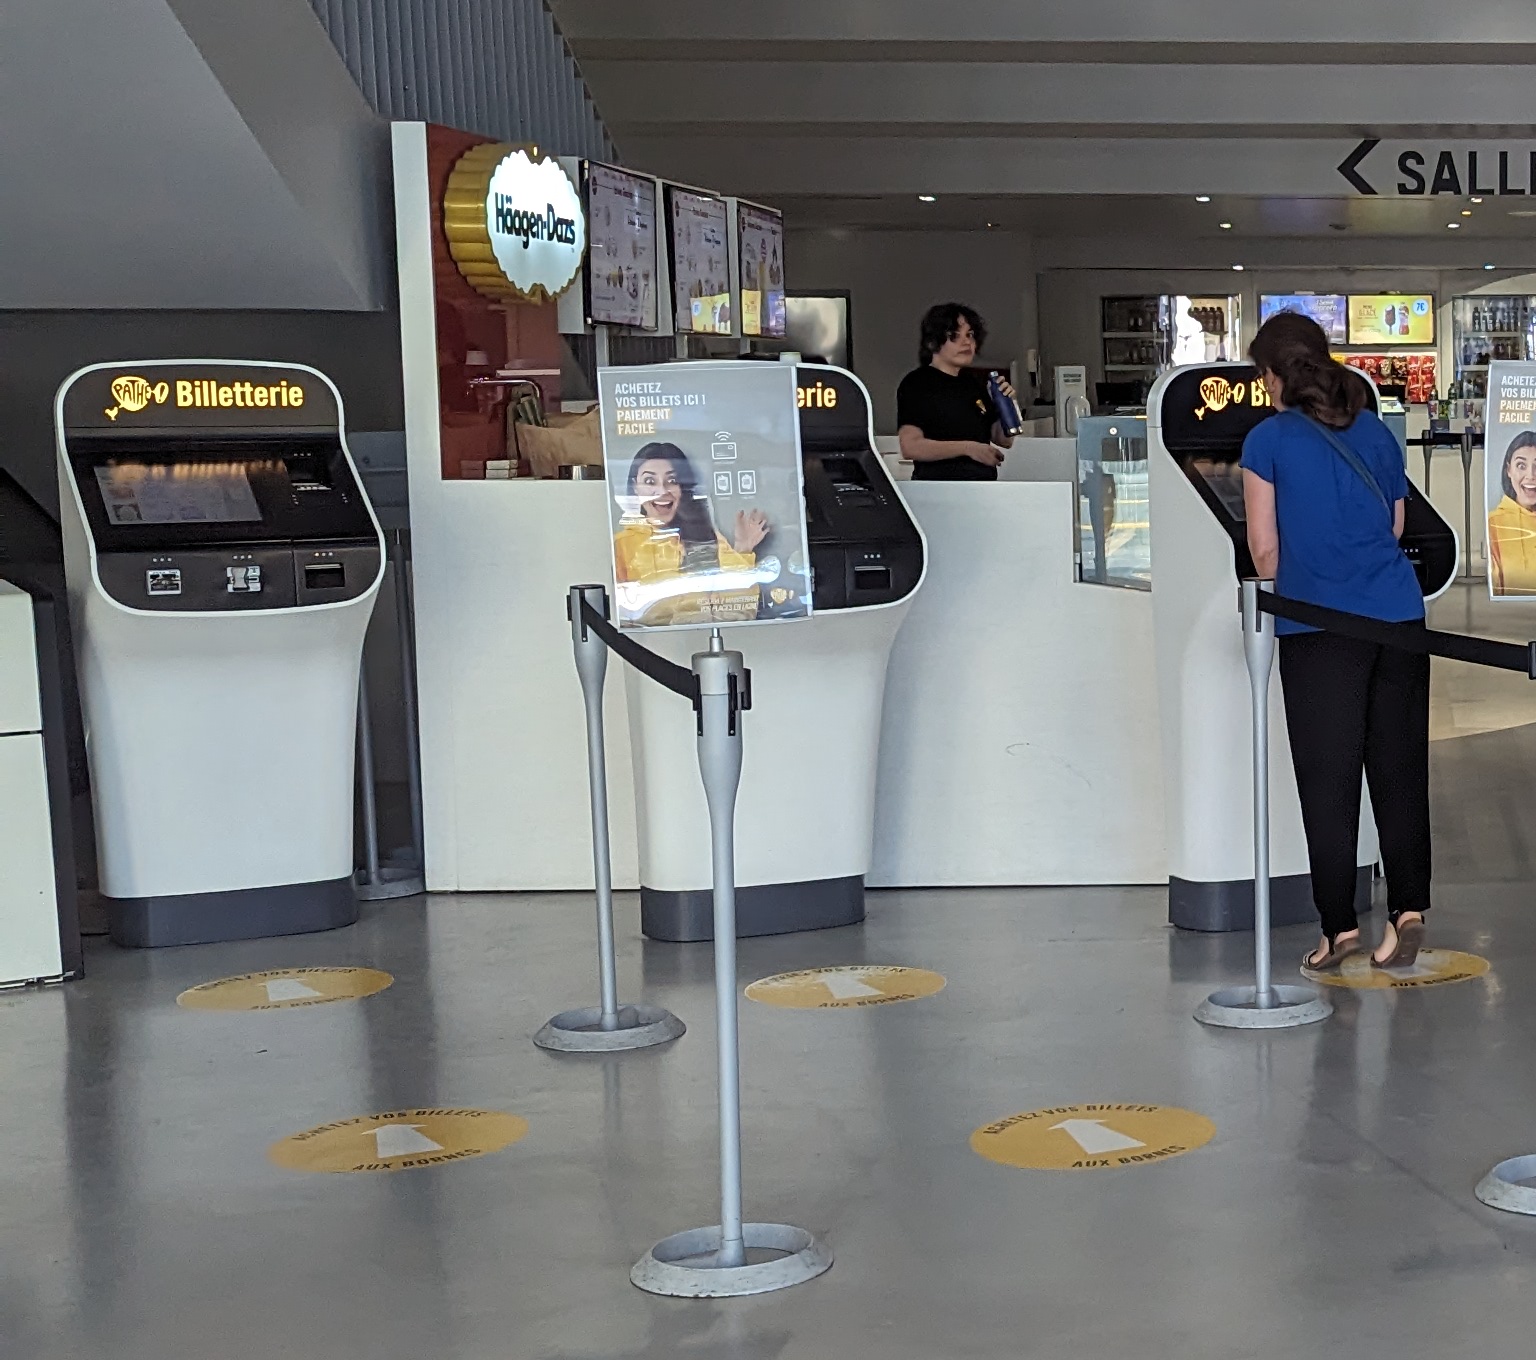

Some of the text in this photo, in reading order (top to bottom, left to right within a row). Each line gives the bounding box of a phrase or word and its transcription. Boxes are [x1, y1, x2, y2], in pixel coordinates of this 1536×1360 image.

[495, 192, 576, 249] Häagen-Dazs
[176, 380, 304, 407] Billetterie
[614, 382, 661, 395] ACHETEZ
[1501, 387, 1518, 398] VOS
[615, 397, 638, 408] VOS
[639, 395, 681, 407] BILLETS
[684, 395, 699, 406] ICI
[616, 408, 671, 421] PAIEMENT
[1500, 413, 1531, 424] FACILE
[618, 423, 655, 435] FACILE
[368, 1112, 408, 1120] VOS
[415, 1109, 488, 1118] BILLETS
[983, 1104, 1158, 1135] ACHETEZ VOS BILLETS
[352, 1147, 481, 1171] AUX BORNES
[1071, 1144, 1187, 1168] AUX BORNES
